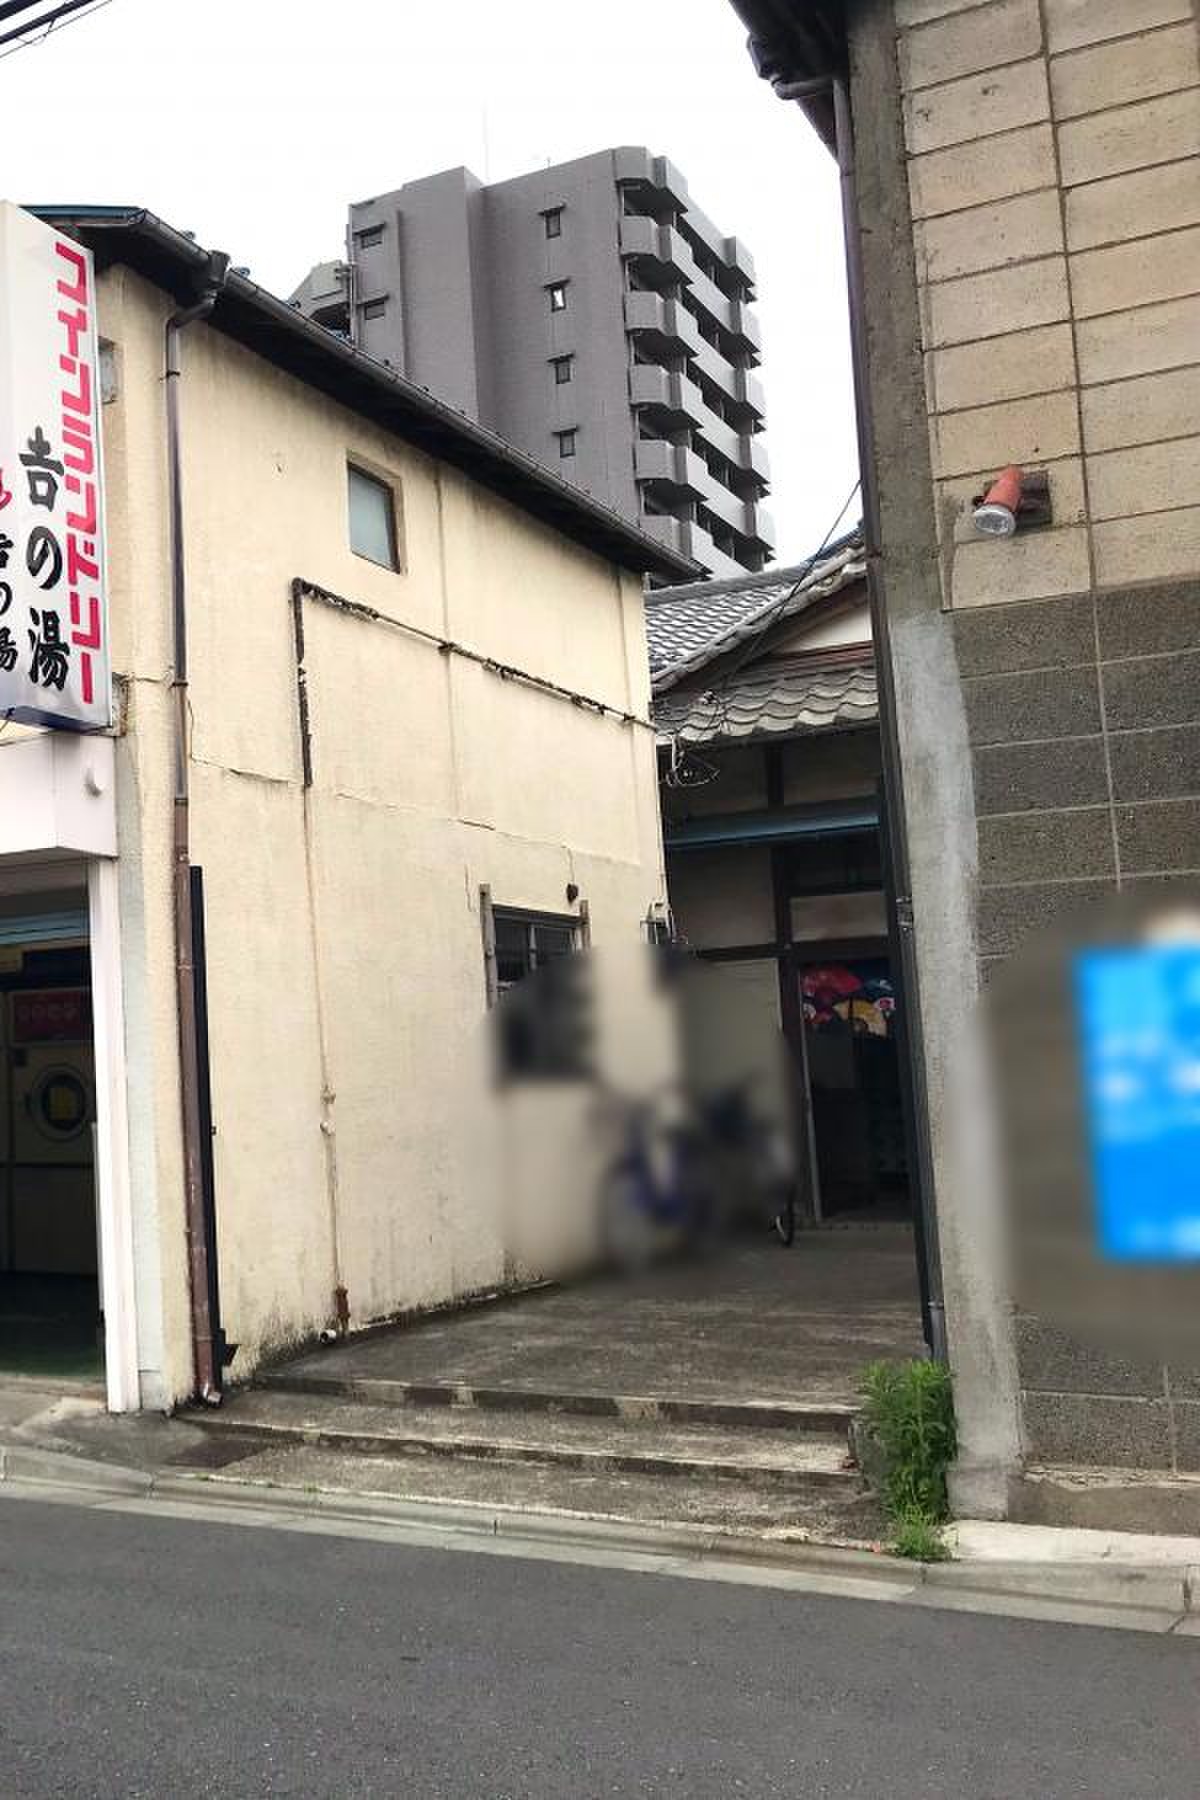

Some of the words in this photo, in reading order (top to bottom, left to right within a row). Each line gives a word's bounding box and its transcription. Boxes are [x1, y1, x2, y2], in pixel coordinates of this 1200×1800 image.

[56, 241, 101, 704] コインランドリー
